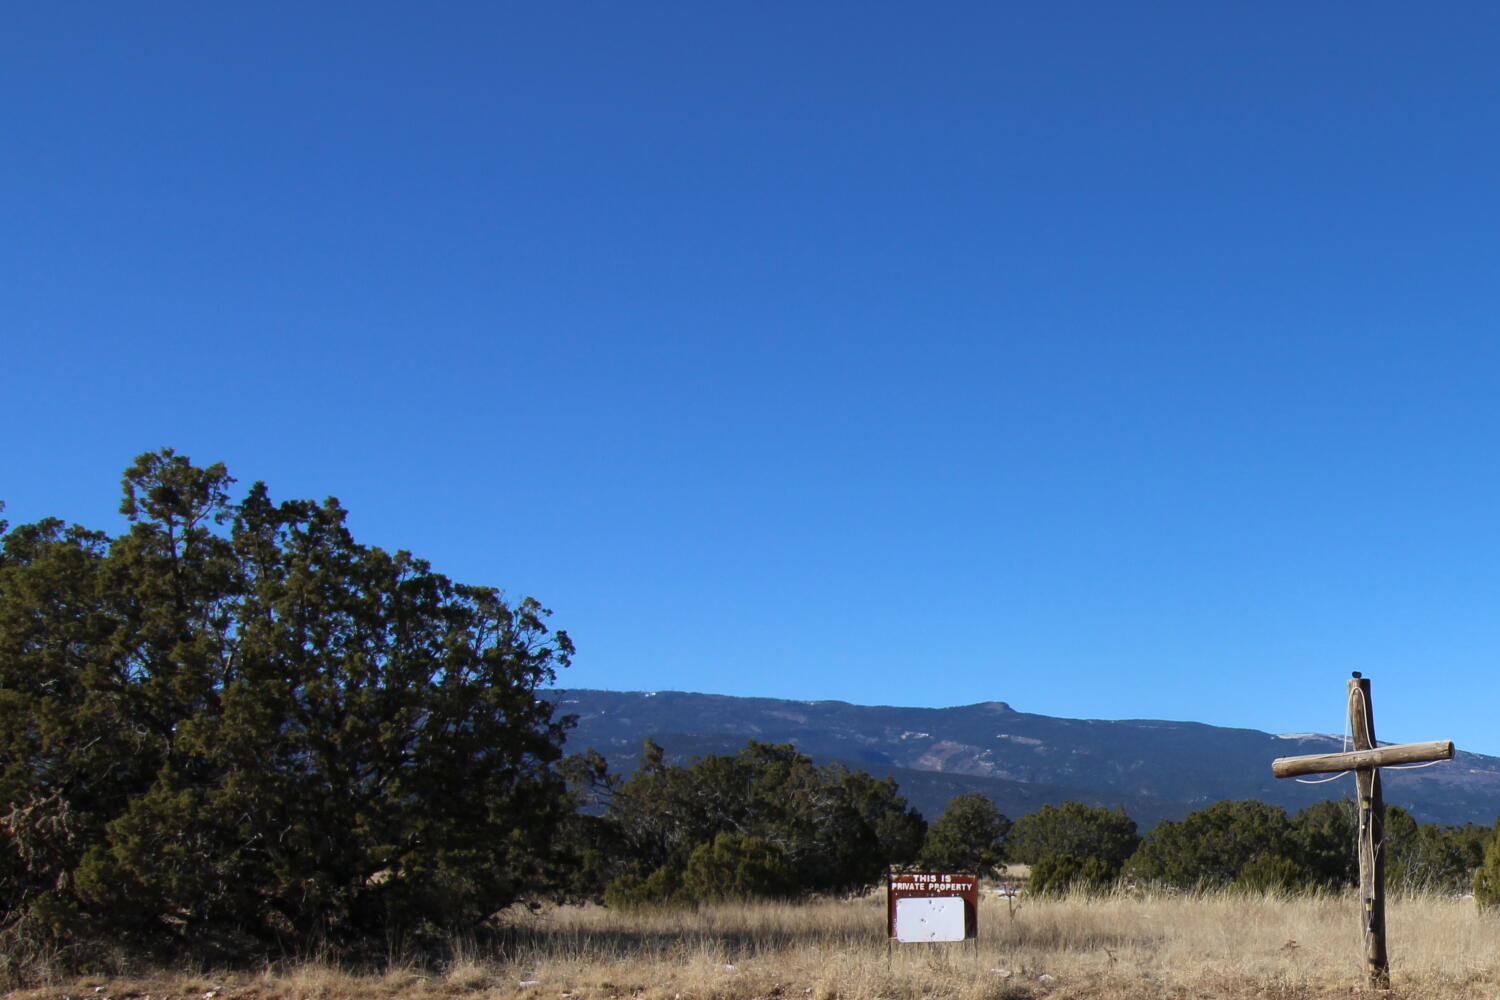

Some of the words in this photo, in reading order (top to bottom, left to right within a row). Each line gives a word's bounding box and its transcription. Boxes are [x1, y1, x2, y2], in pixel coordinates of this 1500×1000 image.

[913, 874, 936, 882] THIS
[941, 874, 952, 882] IS
[928, 883, 972, 891] PROPERTY
